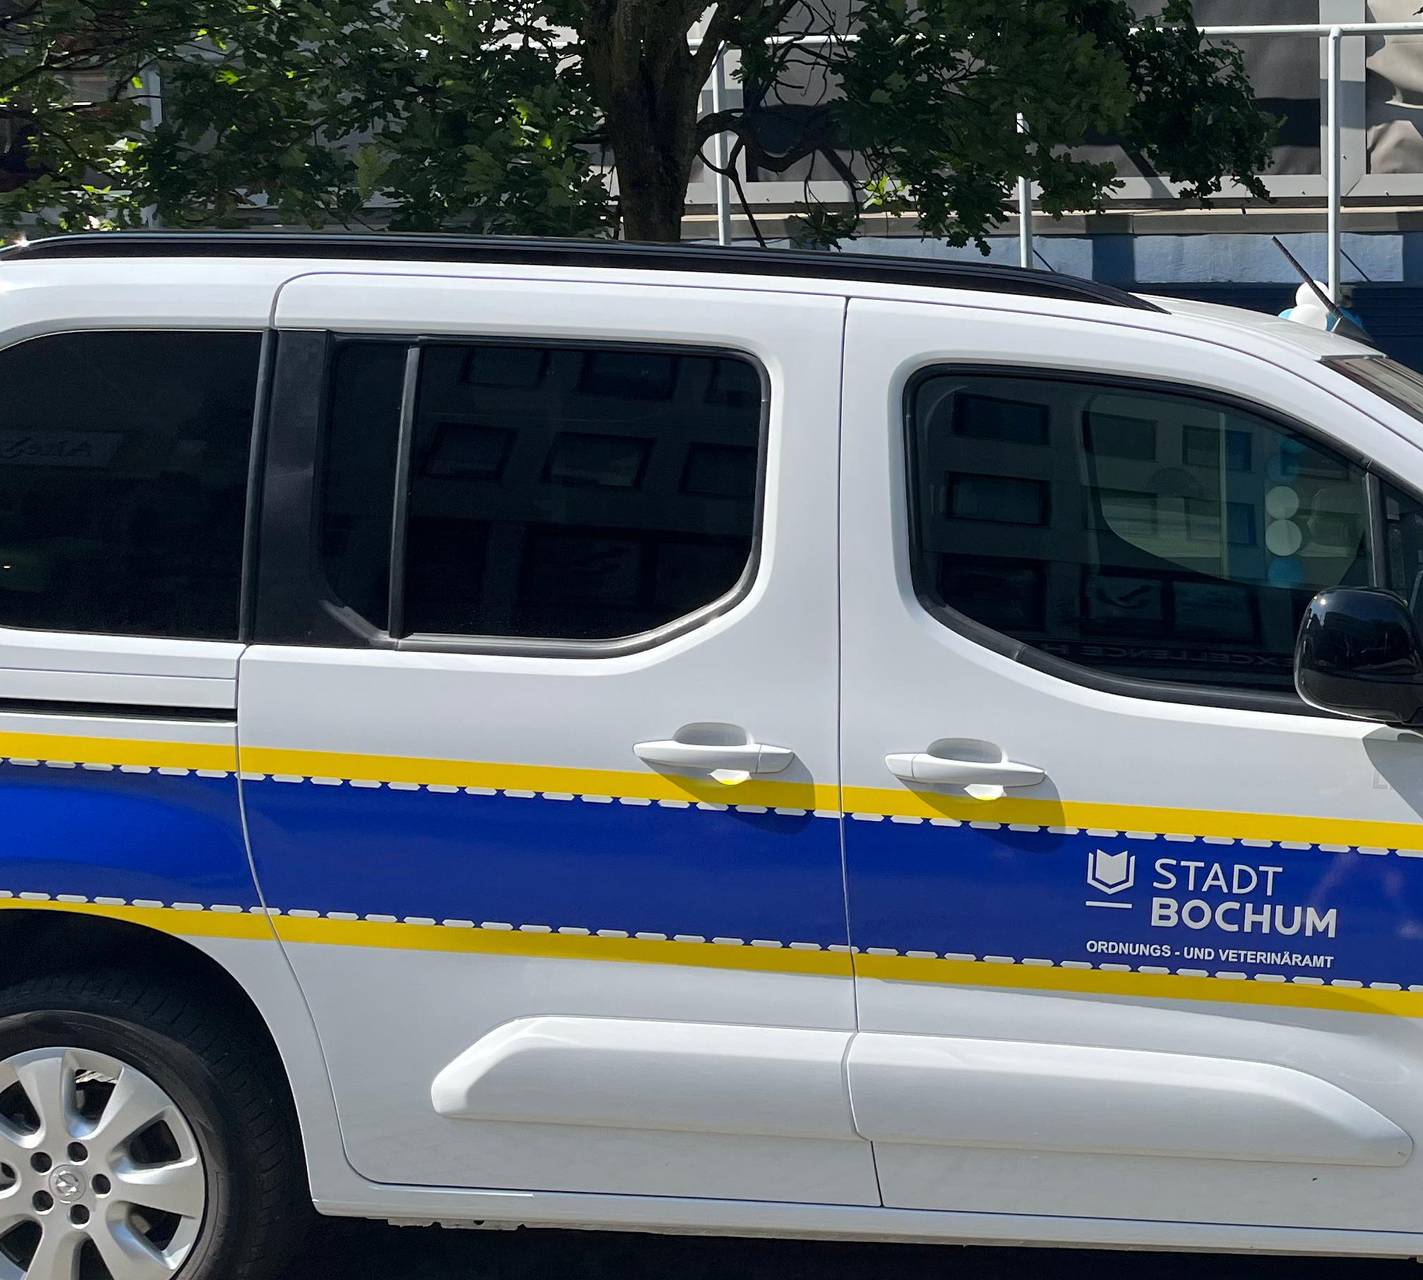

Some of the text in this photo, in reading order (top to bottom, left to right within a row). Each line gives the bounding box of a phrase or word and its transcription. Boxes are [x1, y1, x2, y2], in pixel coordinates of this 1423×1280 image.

[1152, 858, 1283, 897] STADT
[1151, 897, 1337, 938] BOCHUM
[1086, 940, 1171, 957] ORDNUNGS
[1184, 947, 1215, 960] UND
[1218, 948, 1335, 968] VETERINÄRAMT
